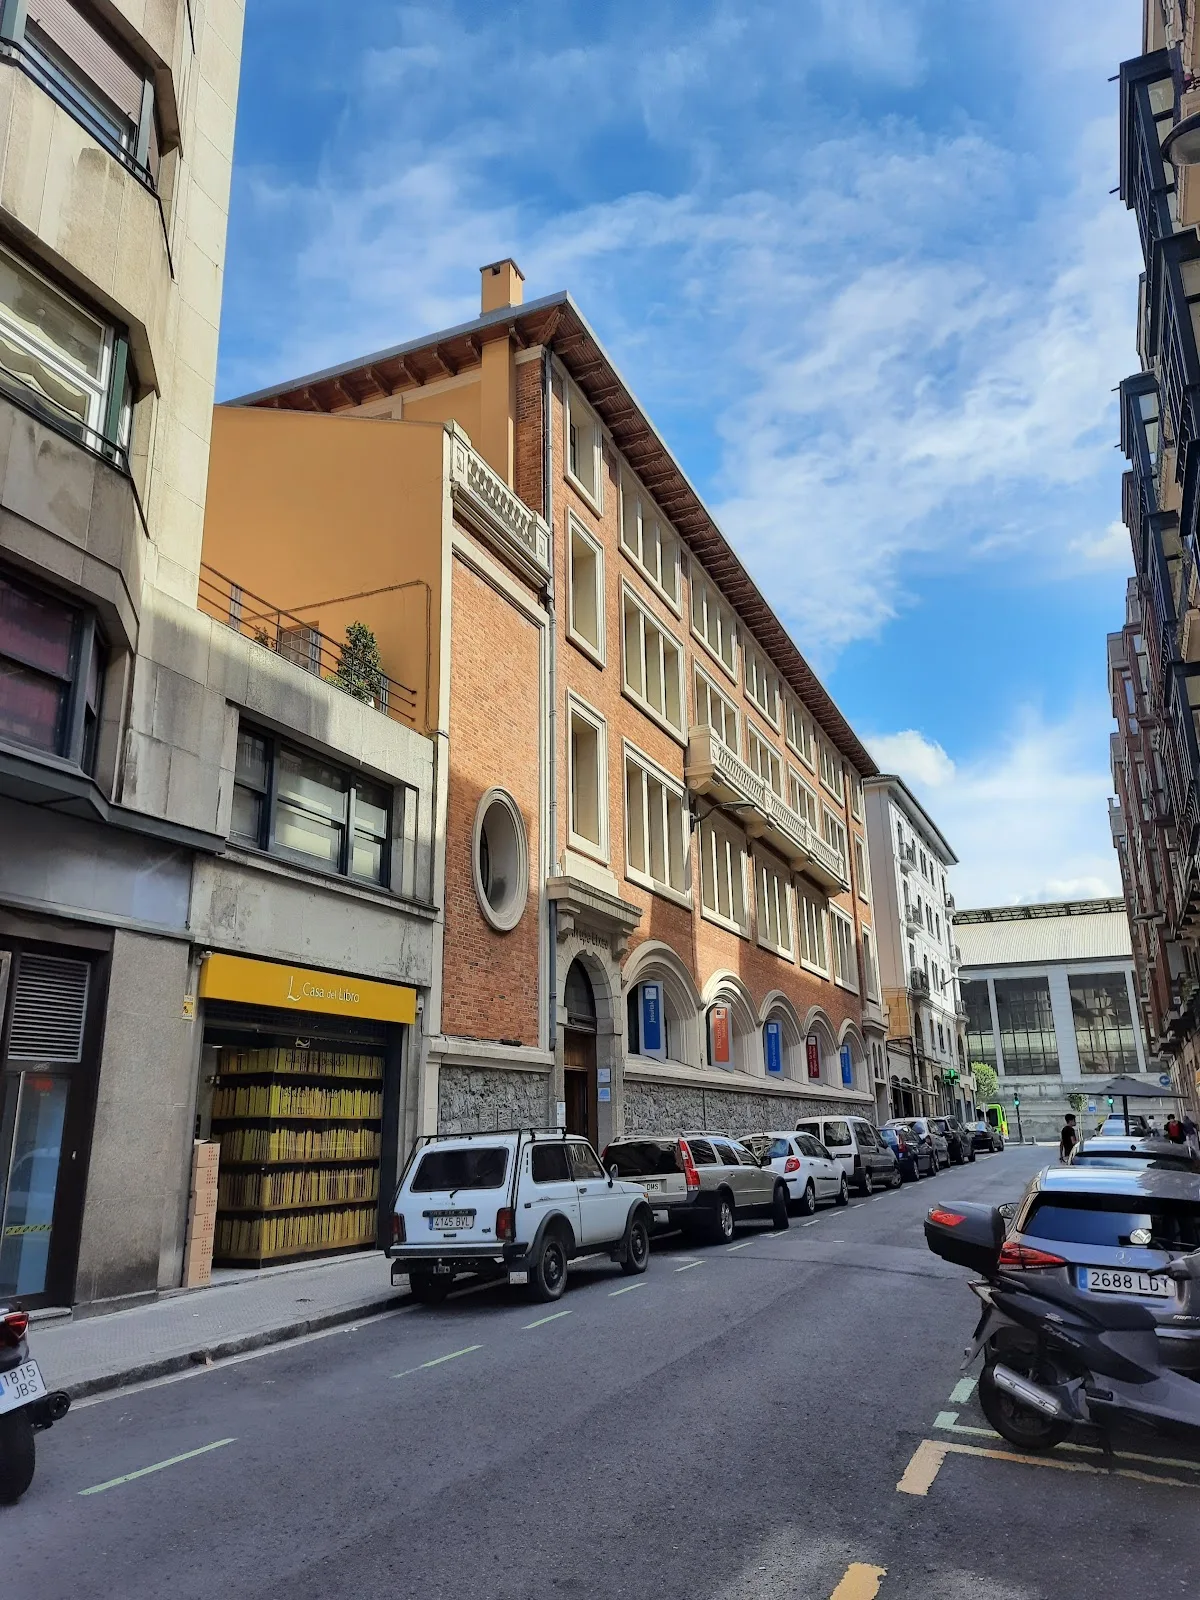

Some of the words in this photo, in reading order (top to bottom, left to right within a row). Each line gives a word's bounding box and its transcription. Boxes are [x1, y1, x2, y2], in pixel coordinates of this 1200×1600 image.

[303, 982, 325, 998] Casa
[326, 989, 337, 1000] del
[339, 987, 360, 1003] Libro
[648, 1000, 657, 1024] Jesuitak
[434, 1217, 454, 1227] 4145
[456, 1216, 470, 1227] BVL
[1091, 1271, 1133, 1289] 2688
[3, 1364, 35, 1387] 1815
[13, 1380, 38, 1400] JBS
